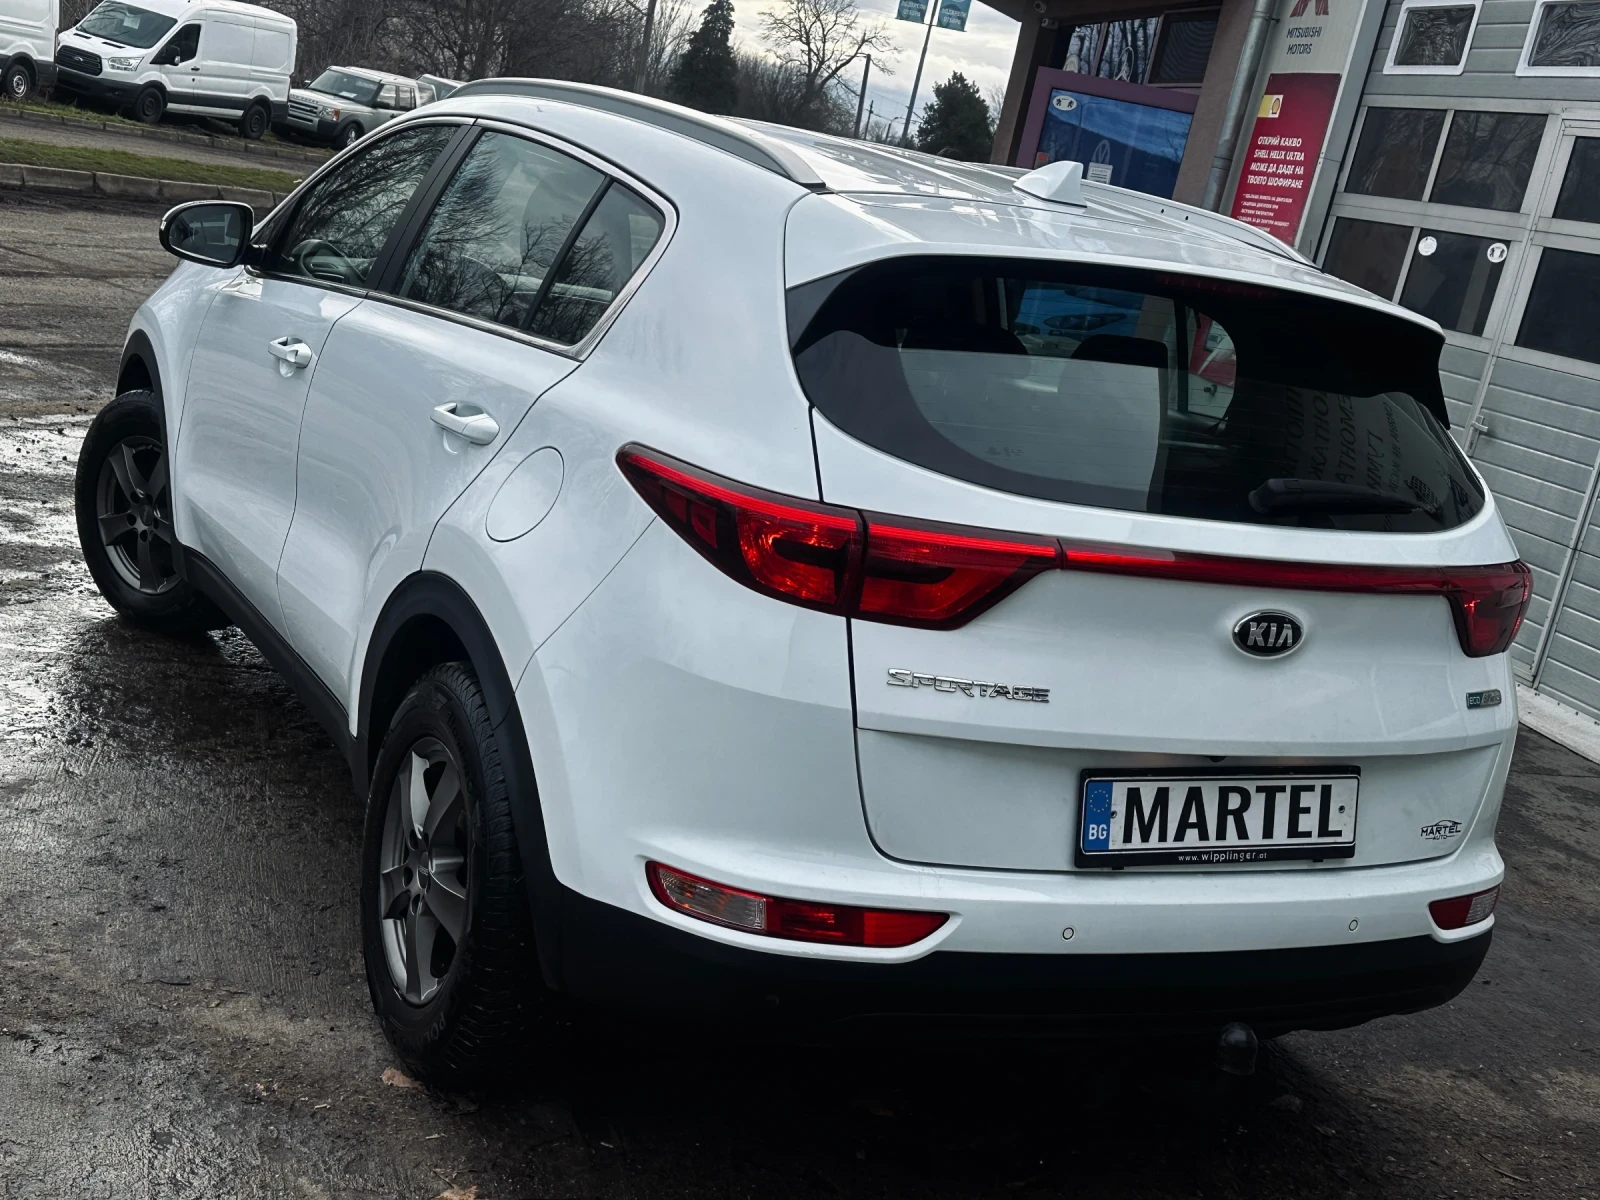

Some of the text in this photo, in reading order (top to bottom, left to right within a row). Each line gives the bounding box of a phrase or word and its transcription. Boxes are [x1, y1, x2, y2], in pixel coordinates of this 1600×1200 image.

[1286, 26, 1322, 38] MITSUBISHI
[1286, 43, 1313, 55] MOTORS
[1257, 135, 1302, 147] ОТКРИЙ КАКВО
[1254, 149, 1305, 161] SHELL HELIX ULTRA
[1250, 162, 1304, 175] МОЖЕ ДА ДАДЕ НА
[1247, 175, 1303, 188] ТВОЕТО ШОФИРАНЕ
[1247, 621, 1293, 647] KIA
[886, 667, 1050, 703] SPORTAGE
[1122, 784, 1343, 844] MARTEL
[1088, 823, 1108, 840] BG
[1420, 823, 1461, 837] MARTEL
